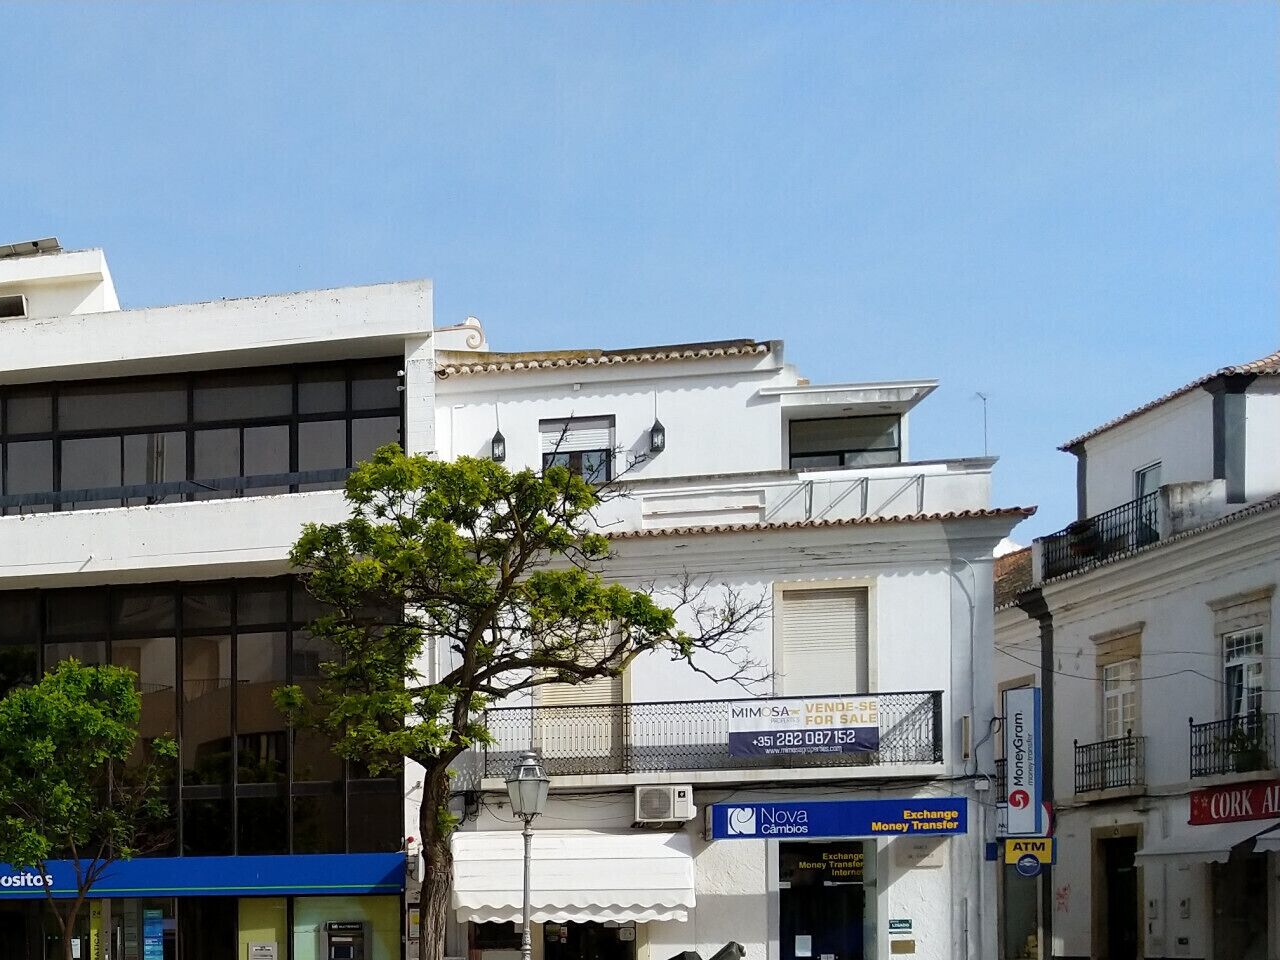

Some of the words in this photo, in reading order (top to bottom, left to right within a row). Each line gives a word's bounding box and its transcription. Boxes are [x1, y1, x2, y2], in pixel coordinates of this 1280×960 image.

[731, 706, 790, 718] MIMOSA
[805, 701, 877, 713] VENDE-SE
[805, 715, 834, 726] FOR
[840, 713, 877, 724] SALE
[752, 736, 774, 747] +351
[777, 732, 803, 746] 282
[1210, 789, 1253, 819] CORK
[761, 808, 808, 823] Nova
[904, 810, 959, 820] Exchange
[761, 823, 808, 834] Câmbios
[872, 821, 908, 832] Money
[912, 820, 959, 830] Transfer
[1012, 842, 1046, 851] ATM
[823, 853, 864, 861] Exchange
[799, 861, 826, 869] Money
